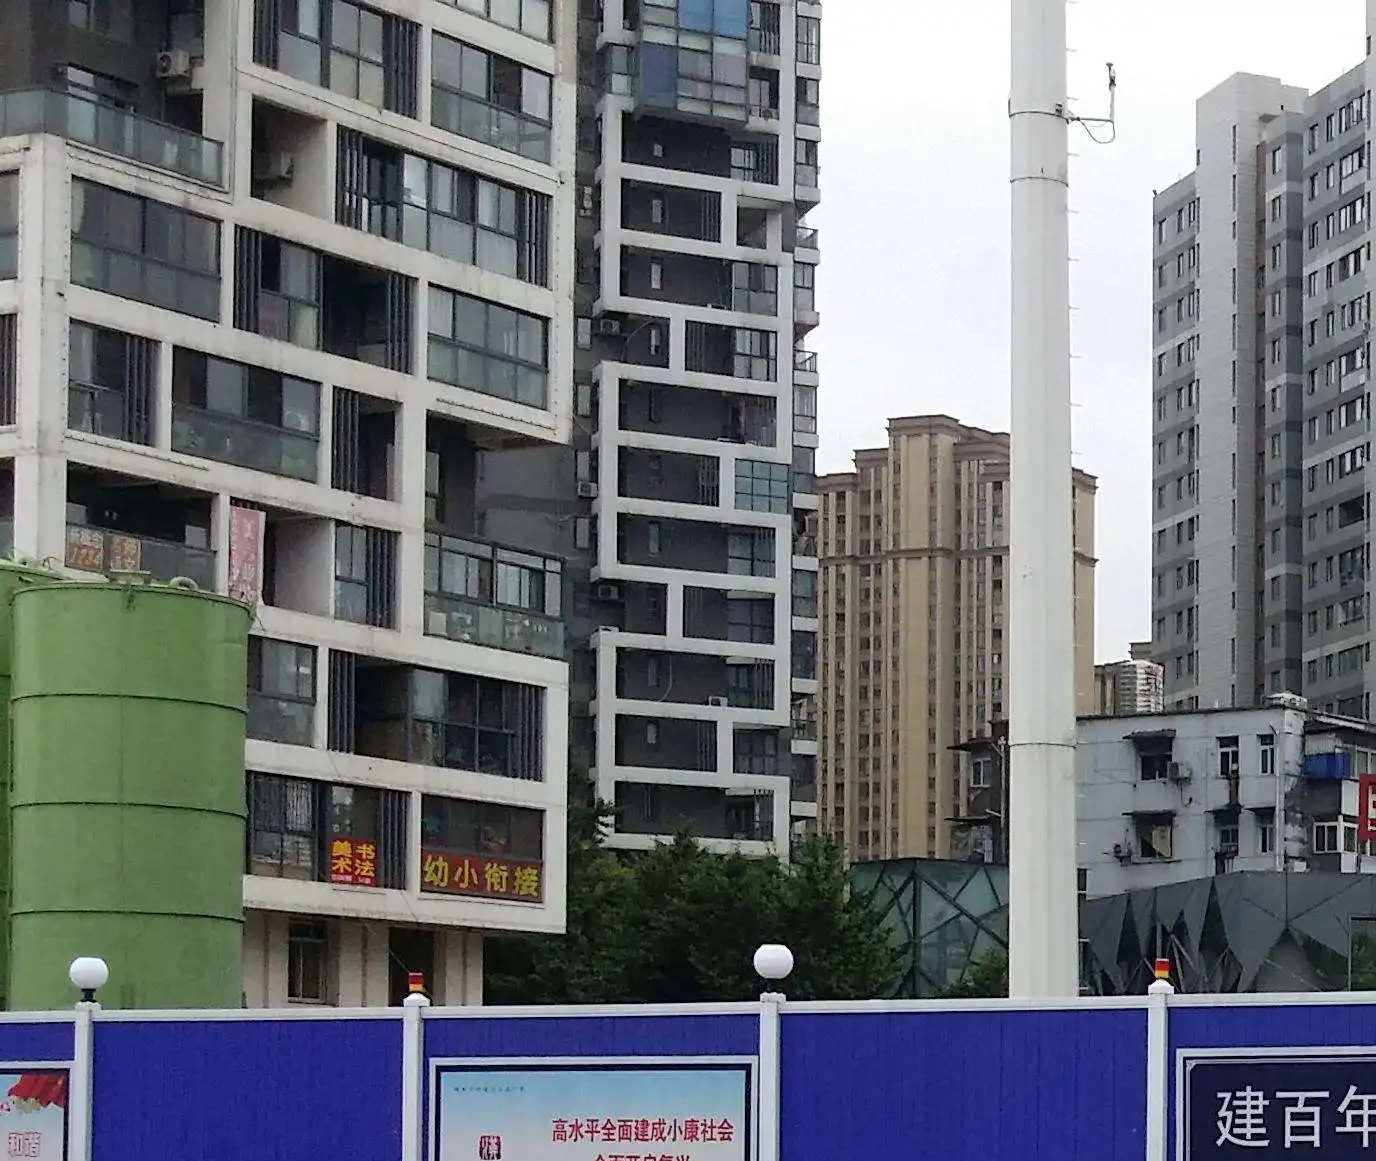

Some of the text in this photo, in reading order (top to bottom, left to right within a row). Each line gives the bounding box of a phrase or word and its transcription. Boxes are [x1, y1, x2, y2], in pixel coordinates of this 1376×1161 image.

[355, 844, 376, 878] 书法
[423, 854, 539, 897] 幼小衔接
[8, 1131, 41, 1157] 和谐
[552, 1118, 734, 1142] 高水平全面建成小康社会
